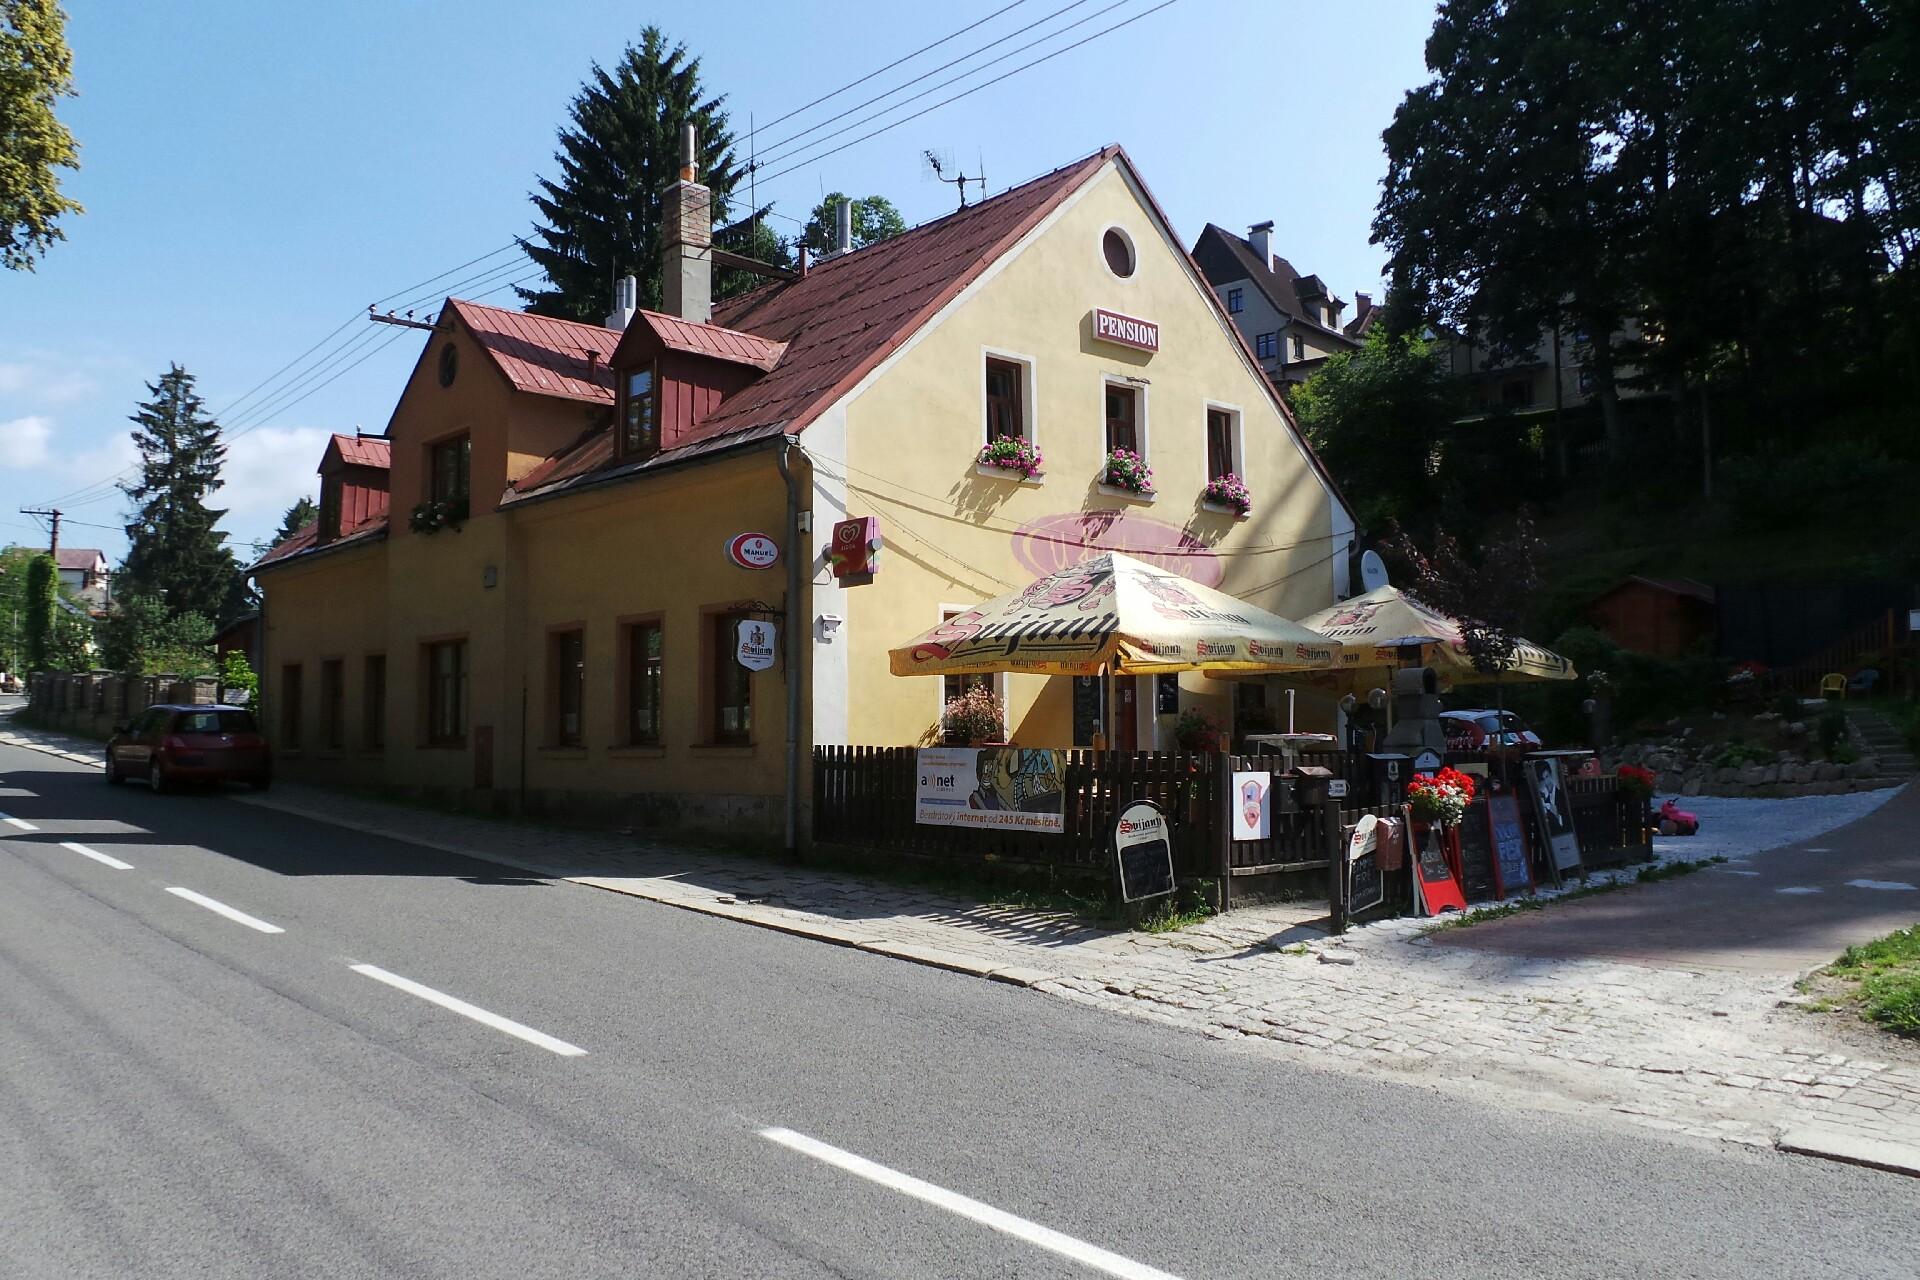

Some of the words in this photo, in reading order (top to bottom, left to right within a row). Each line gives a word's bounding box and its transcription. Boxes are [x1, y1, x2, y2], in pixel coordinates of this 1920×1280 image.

[1099, 313, 1157, 347] PENSION
[743, 548, 774, 557] MANUEL
[911, 611, 1121, 664] Svijany
[740, 642, 773, 656] Svijany
[1140, 638, 1181, 657] Svijany
[1196, 638, 1236, 657] Svijany
[1249, 638, 1284, 658] Svijany
[1295, 641, 1331, 660] Svijany
[936, 774, 955, 787] net
[919, 809, 956, 821] Bezdrátový
[957, 812, 987, 823] internet
[988, 815, 998, 824] od
[998, 815, 1014, 825] 245
[1014, 815, 1025, 826] Kč
[1025, 816, 1061, 828] měsíčně.
[1119, 817, 1162, 835] Svijany
